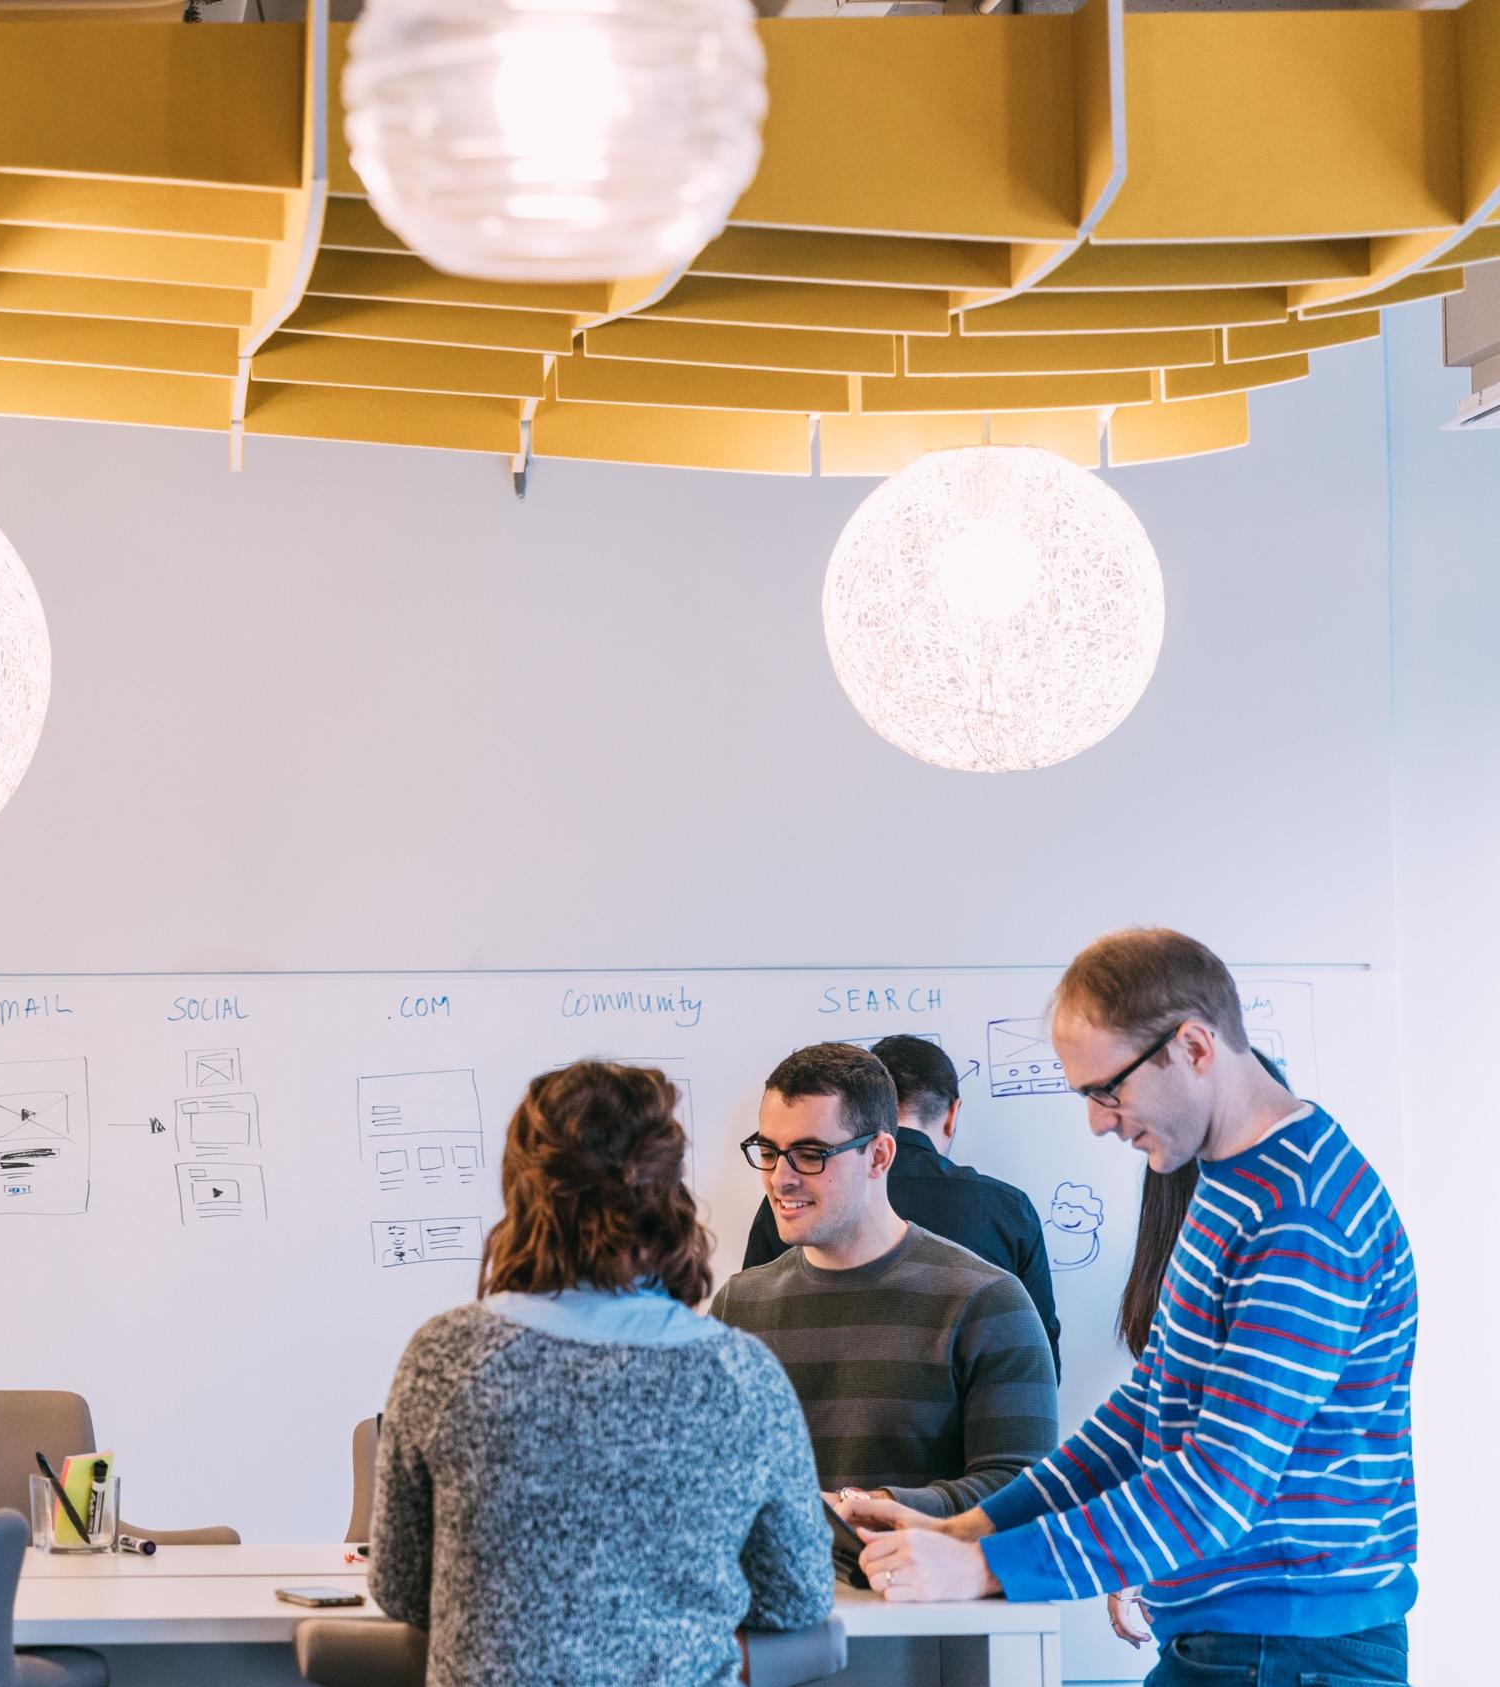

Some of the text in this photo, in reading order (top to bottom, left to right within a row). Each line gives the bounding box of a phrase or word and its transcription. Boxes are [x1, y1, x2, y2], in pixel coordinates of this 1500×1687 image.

[167, 996, 250, 1021] SOCIAL
[387, 995, 451, 1020] .COM
[818, 986, 942, 1013] SEARCH
